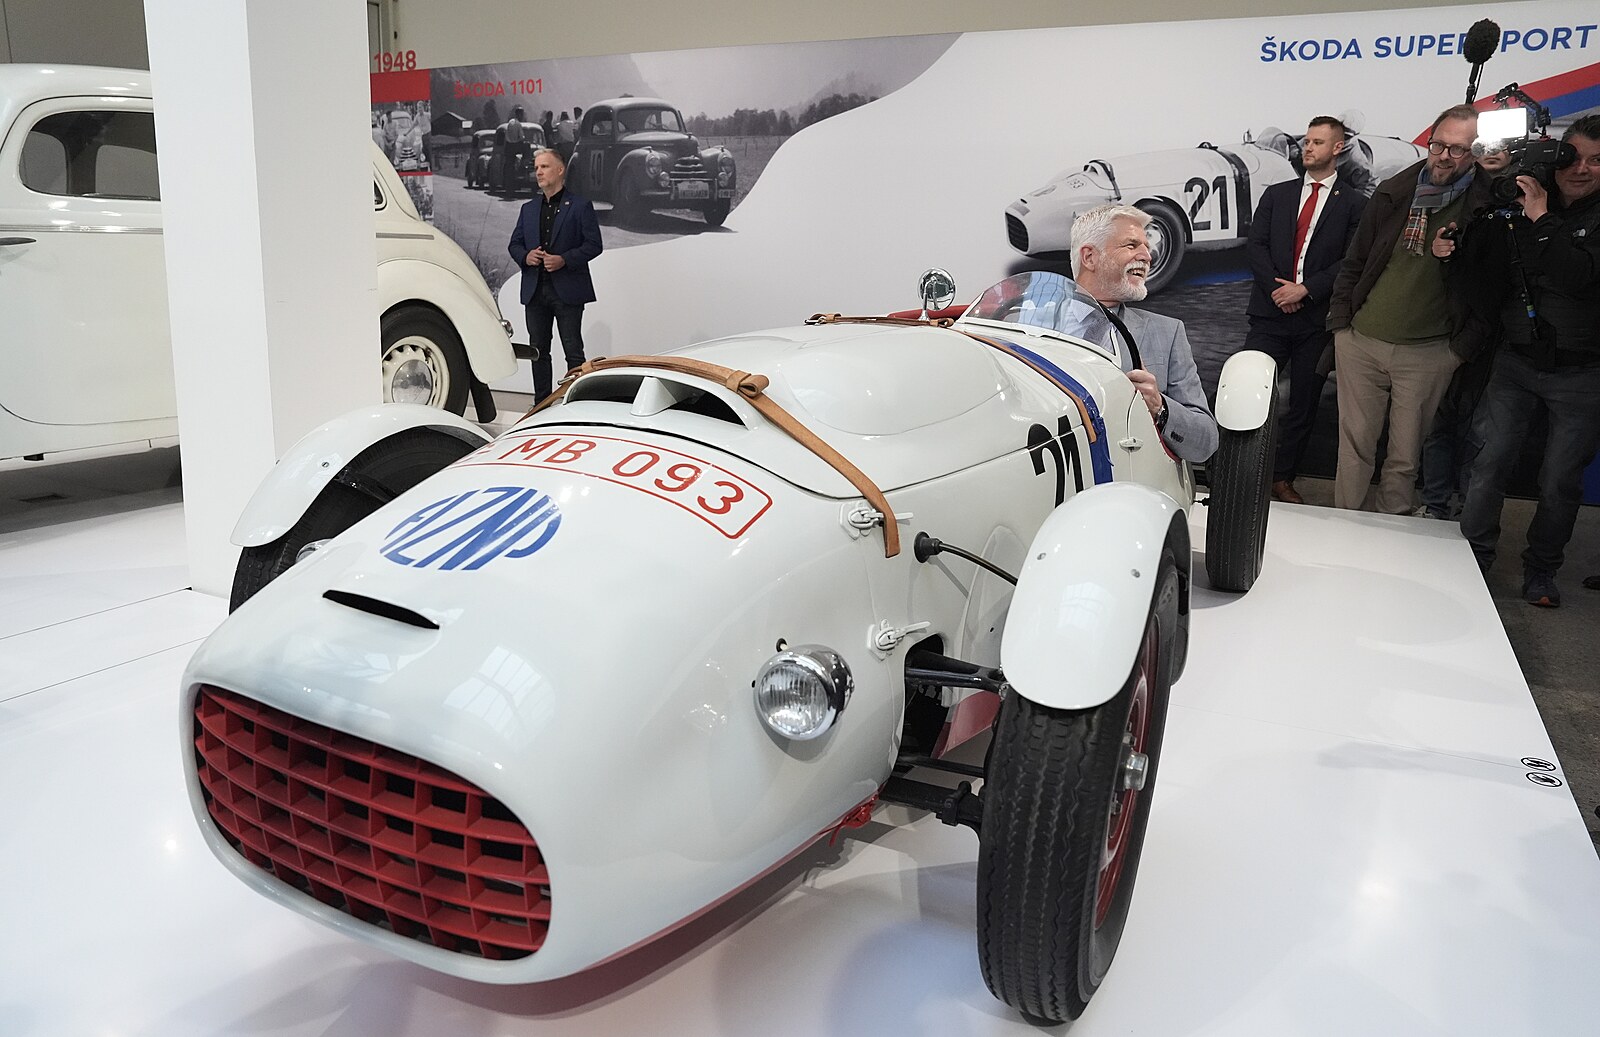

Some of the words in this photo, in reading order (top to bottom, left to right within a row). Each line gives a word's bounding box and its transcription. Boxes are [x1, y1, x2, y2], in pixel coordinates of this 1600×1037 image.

[373, 50, 417, 72] 1948
[1260, 36, 1362, 62] ŠKODA
[454, 79, 505, 98] ŠKODA
[510, 79, 543, 95] 1101
[1184, 175, 1230, 232] 21
[611, 451, 744, 515] 093
